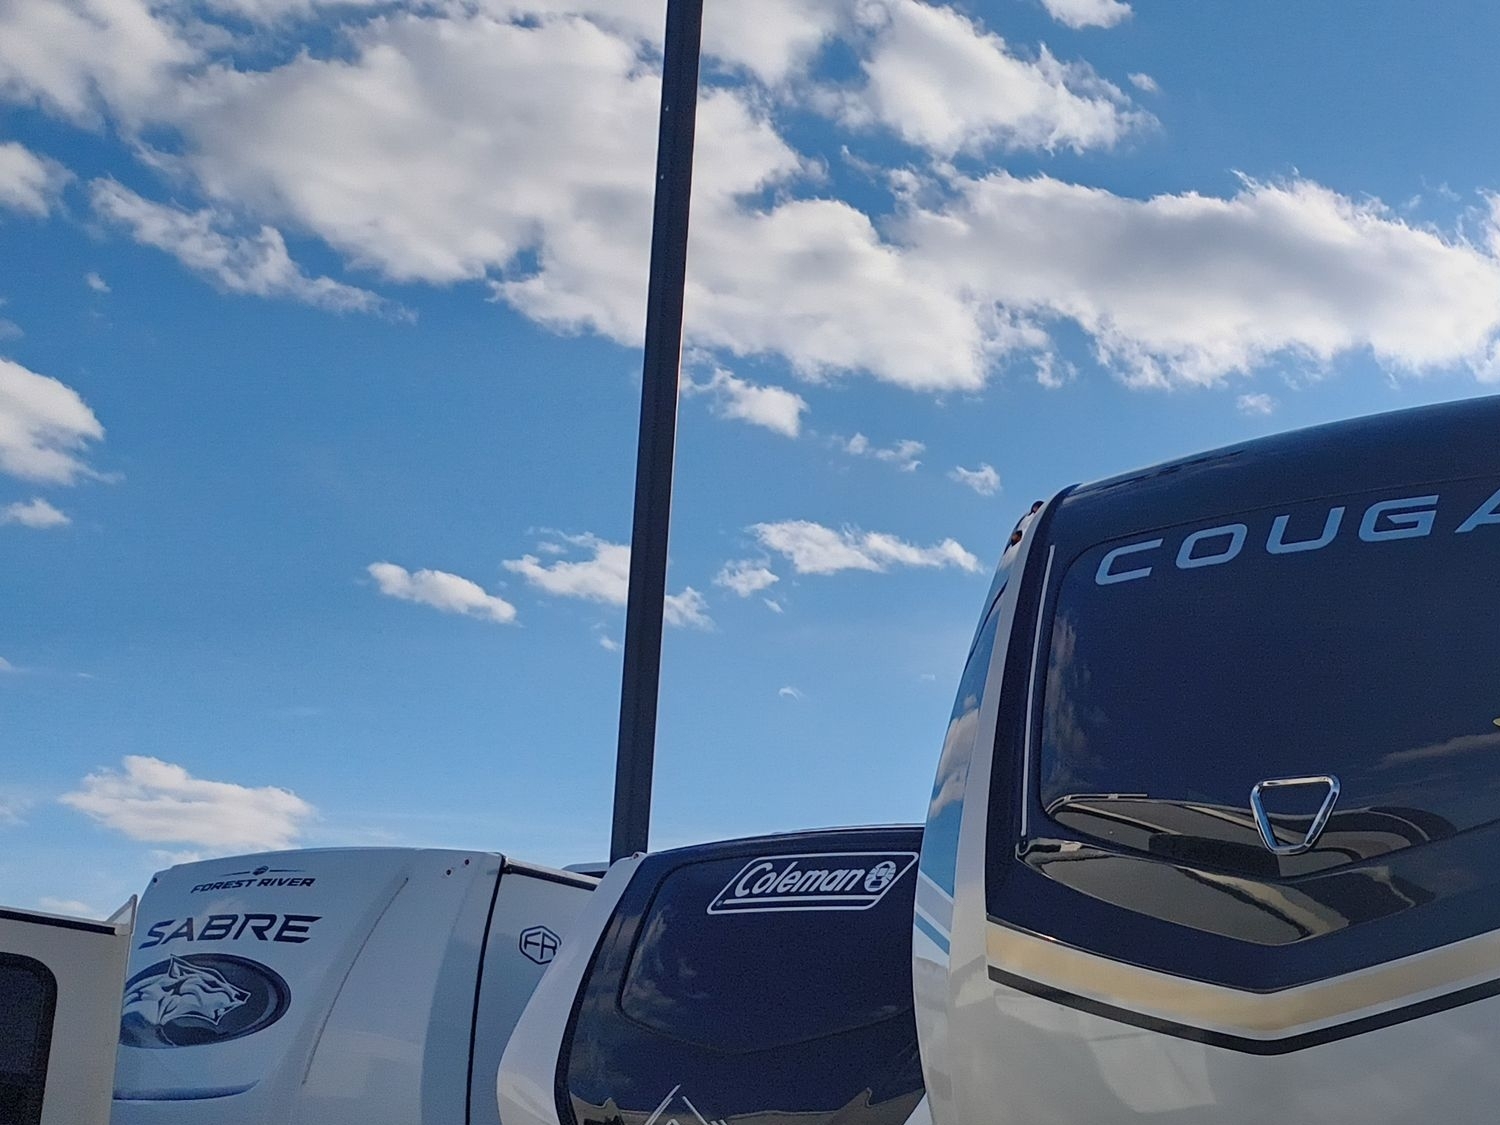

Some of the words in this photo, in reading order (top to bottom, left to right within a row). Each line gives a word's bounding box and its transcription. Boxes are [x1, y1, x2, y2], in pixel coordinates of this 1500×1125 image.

[190, 878, 258, 894] FOREST
[257, 877, 317, 888] RIVER
[735, 861, 866, 898] Coleman
[138, 913, 323, 950] SABRE
